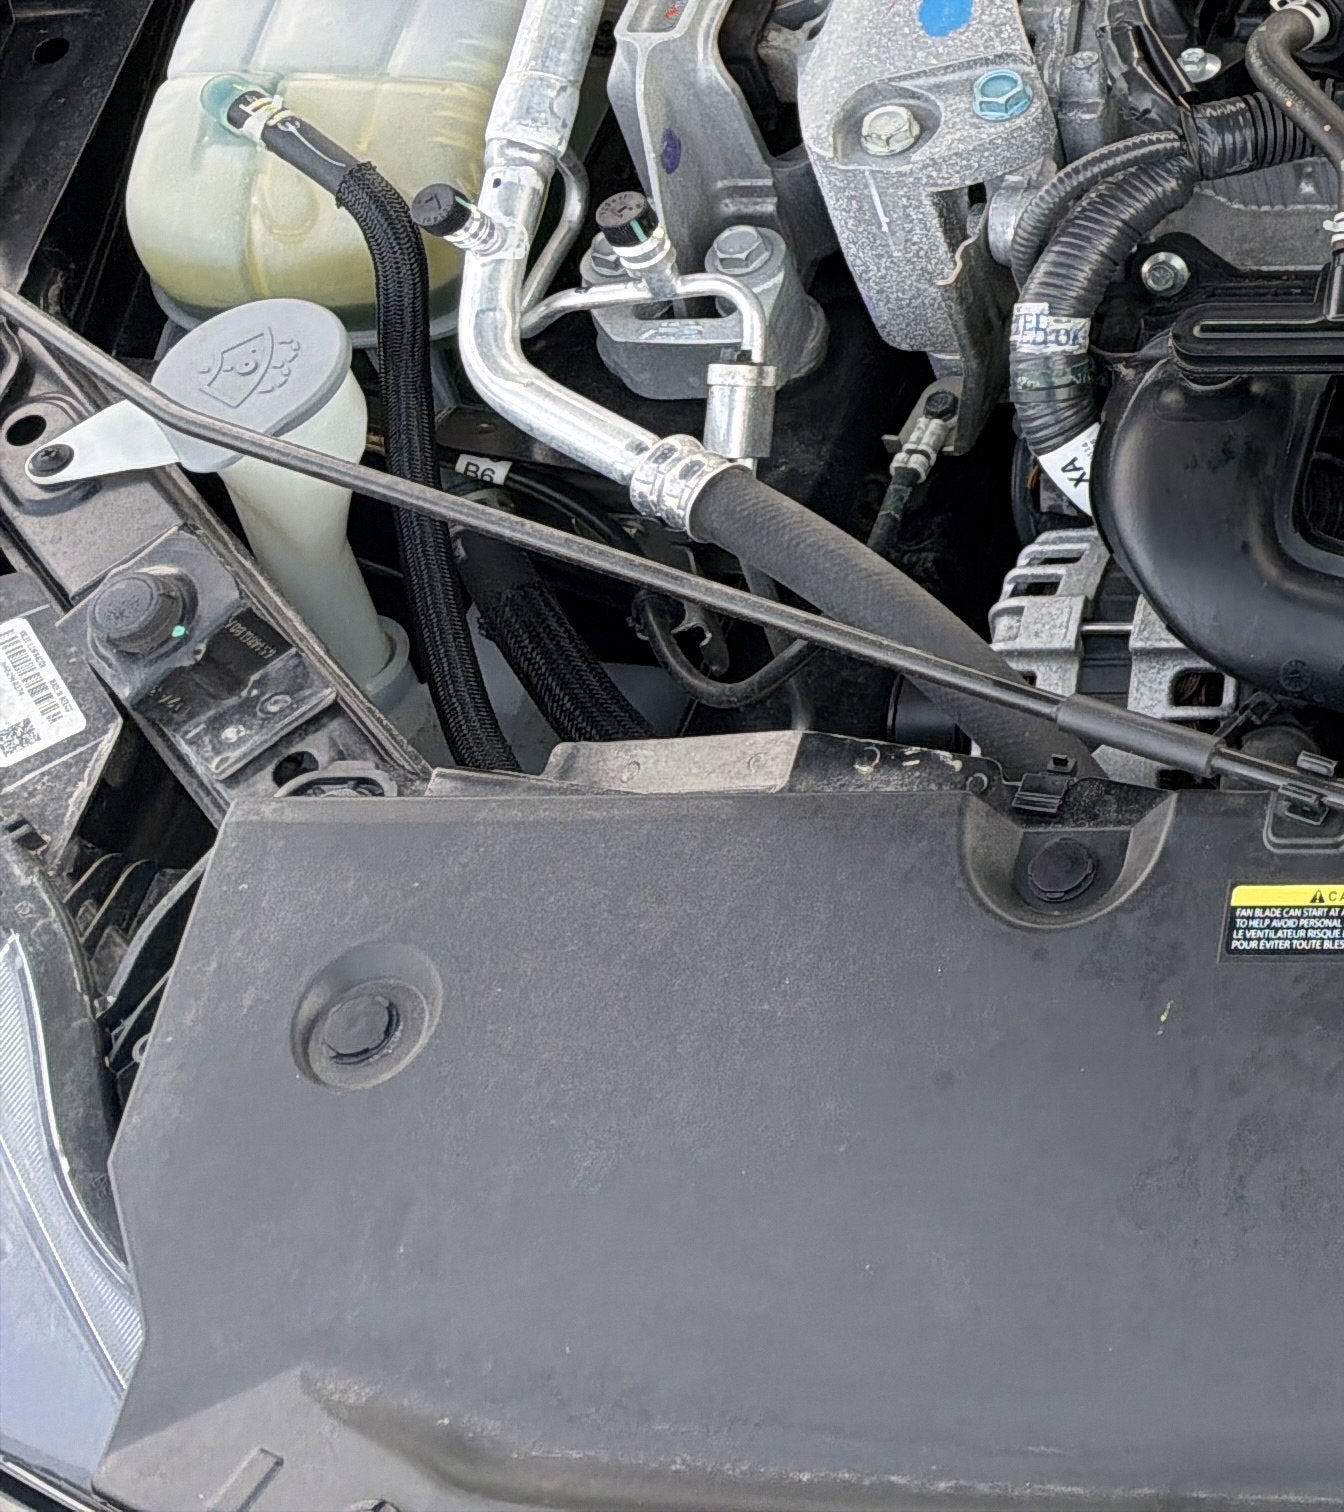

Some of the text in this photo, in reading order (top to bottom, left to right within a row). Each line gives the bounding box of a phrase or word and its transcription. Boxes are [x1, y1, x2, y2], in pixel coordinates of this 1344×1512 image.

[1235, 907, 1253, 917] FAN
[1253, 907, 1282, 917] BLADE
[1282, 907, 1302, 917] CAN
[1302, 907, 1328, 917] START
[1328, 907, 1340, 917] AT
[1235, 918, 1249, 929] TO
[1249, 918, 1270, 928] HELP
[1270, 918, 1298, 928] AVOID
[1299, 918, 1342, 928] PERSONAL
[1232, 929, 1245, 939] LE
[1245, 929, 1307, 939] VENTILATEUR
[1307, 928, 1341, 940] RISQUE
[1231, 940, 1259, 950] POUR
[1259, 938, 1291, 950] ÉVITER
[1291, 939, 1323, 950] TOUTE
